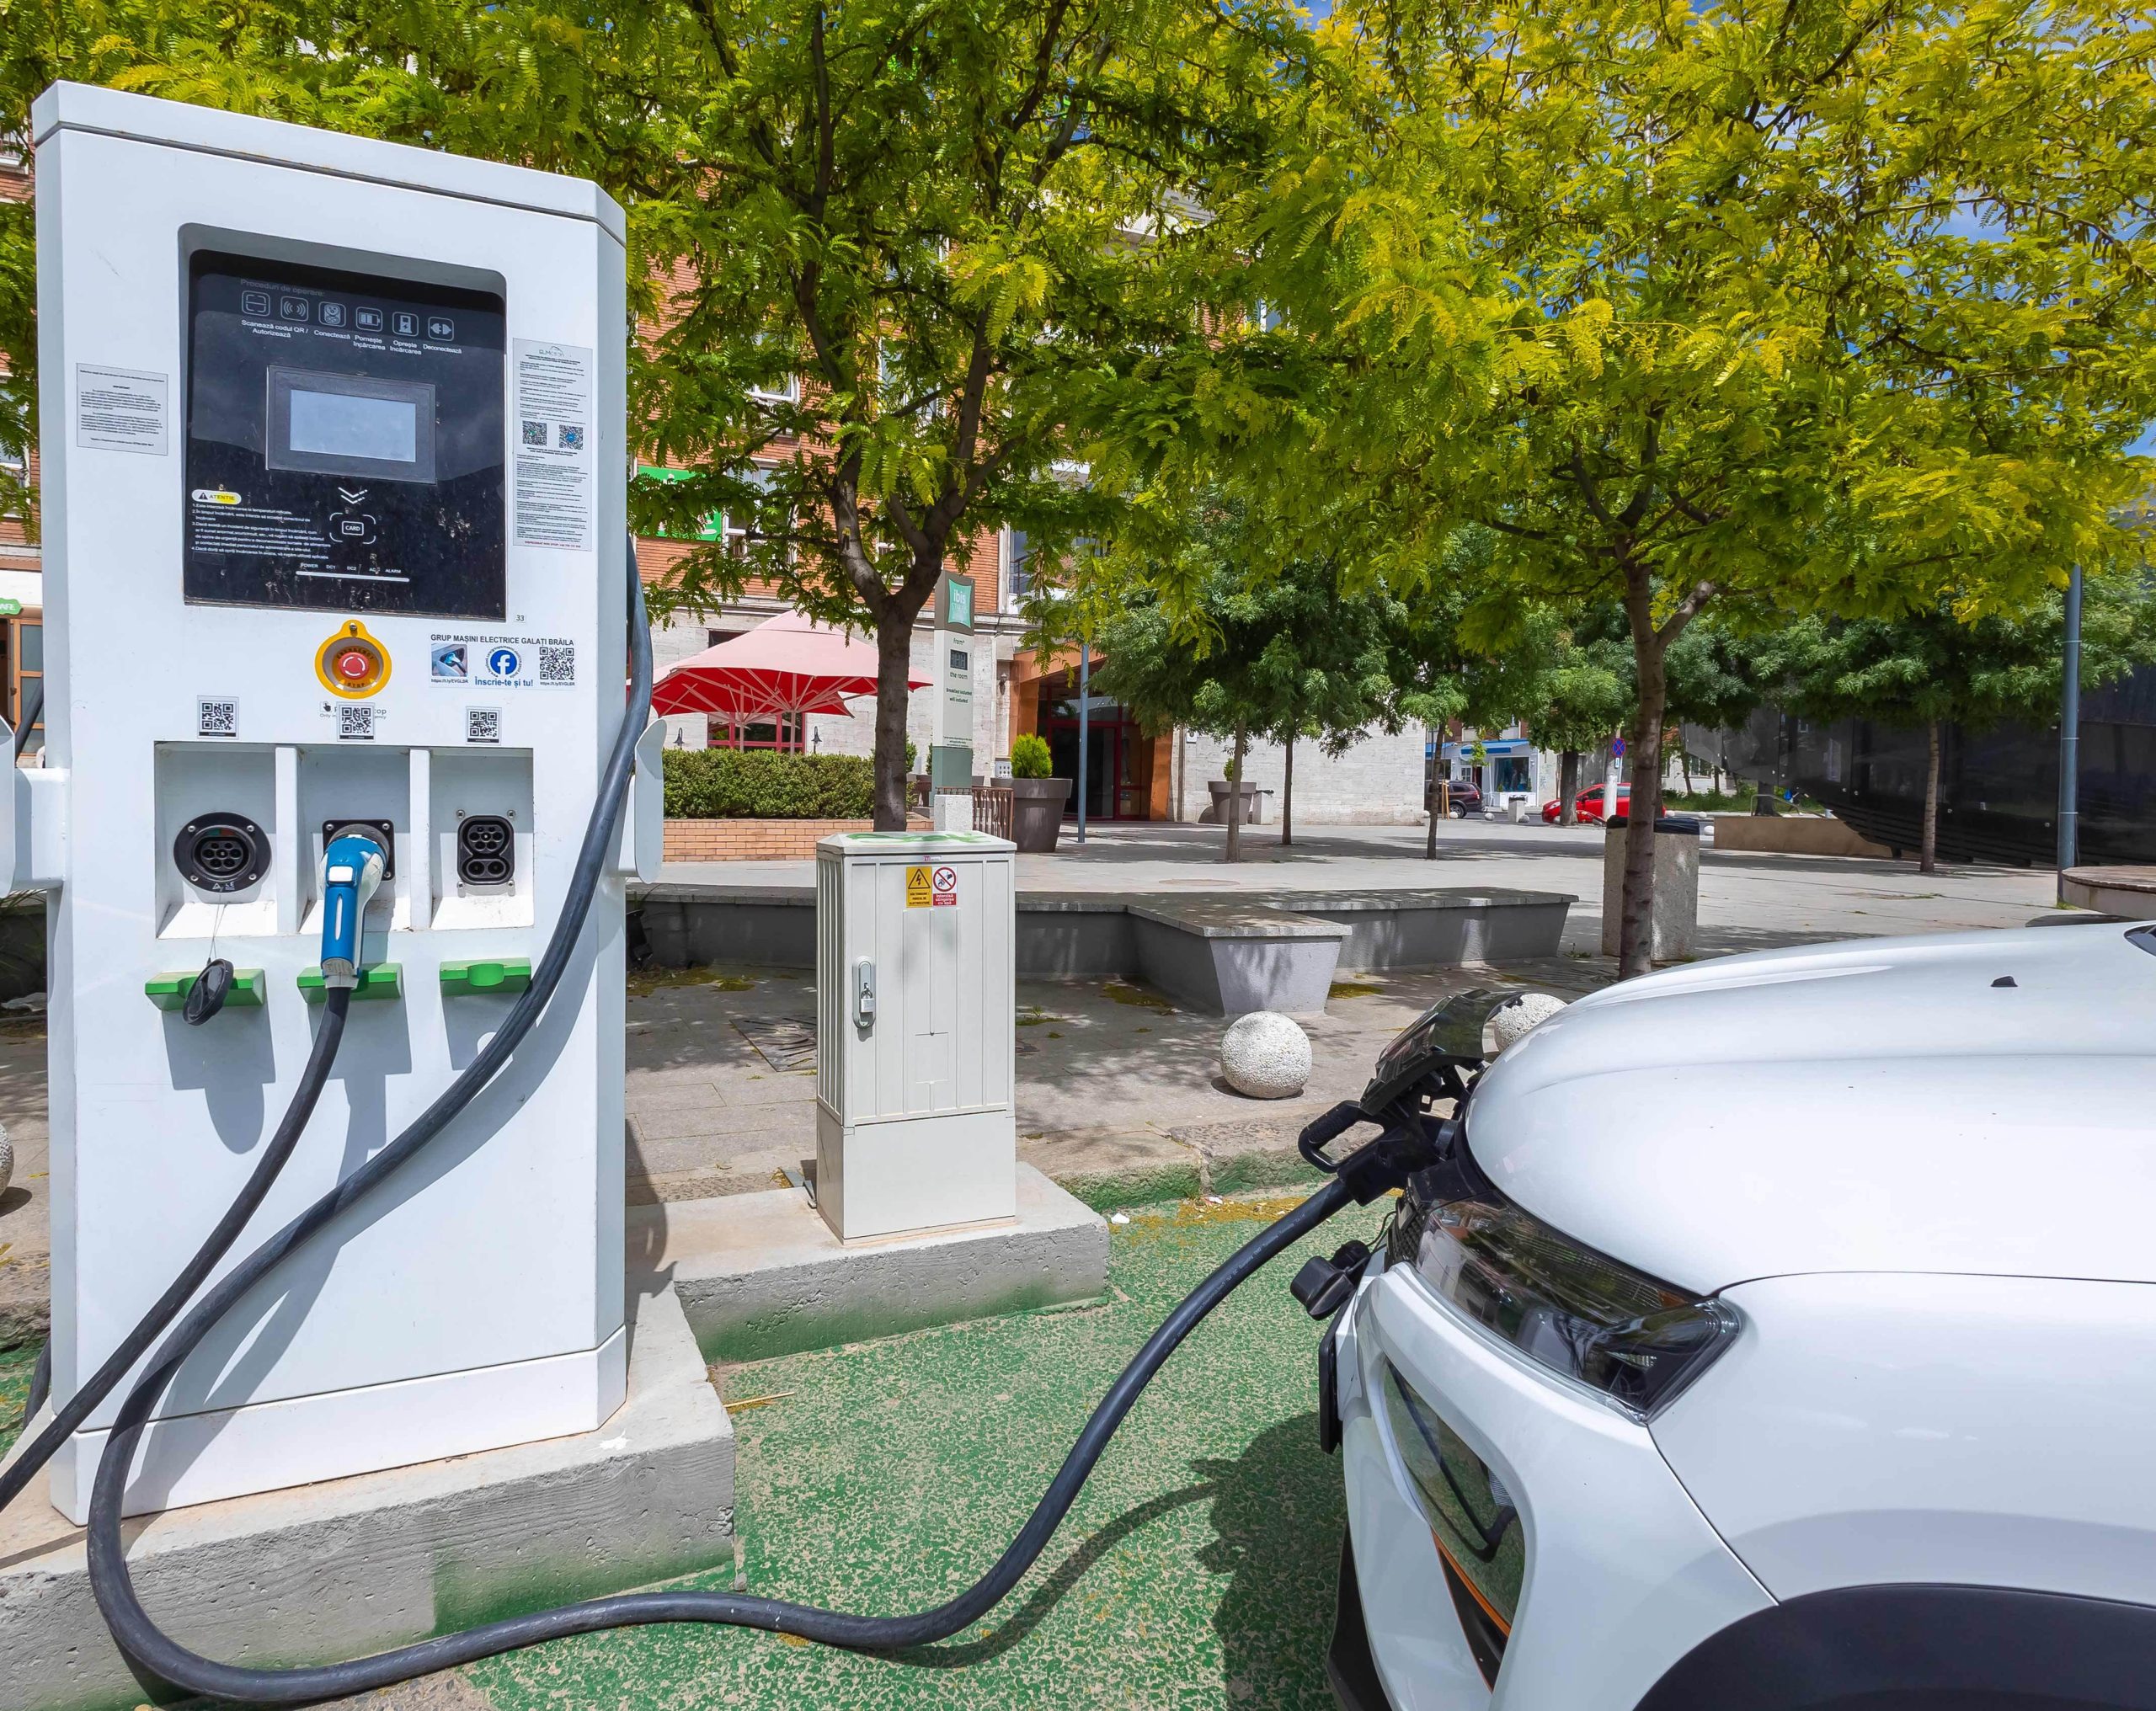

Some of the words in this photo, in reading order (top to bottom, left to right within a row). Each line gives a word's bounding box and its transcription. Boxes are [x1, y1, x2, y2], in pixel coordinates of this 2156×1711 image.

[253, 328, 291, 338] Autorizează
[313, 329, 351, 339] Conectează
[954, 589, 966, 604] ibis
[453, 635, 478, 644] MAȘINI
[479, 636, 520, 644] ELECTRICE
[521, 637, 547, 647] GALAȚI
[548, 637, 574, 646] BRĂILA
[475, 676, 512, 686] Înscrie-te
[514, 679, 520, 688] și
